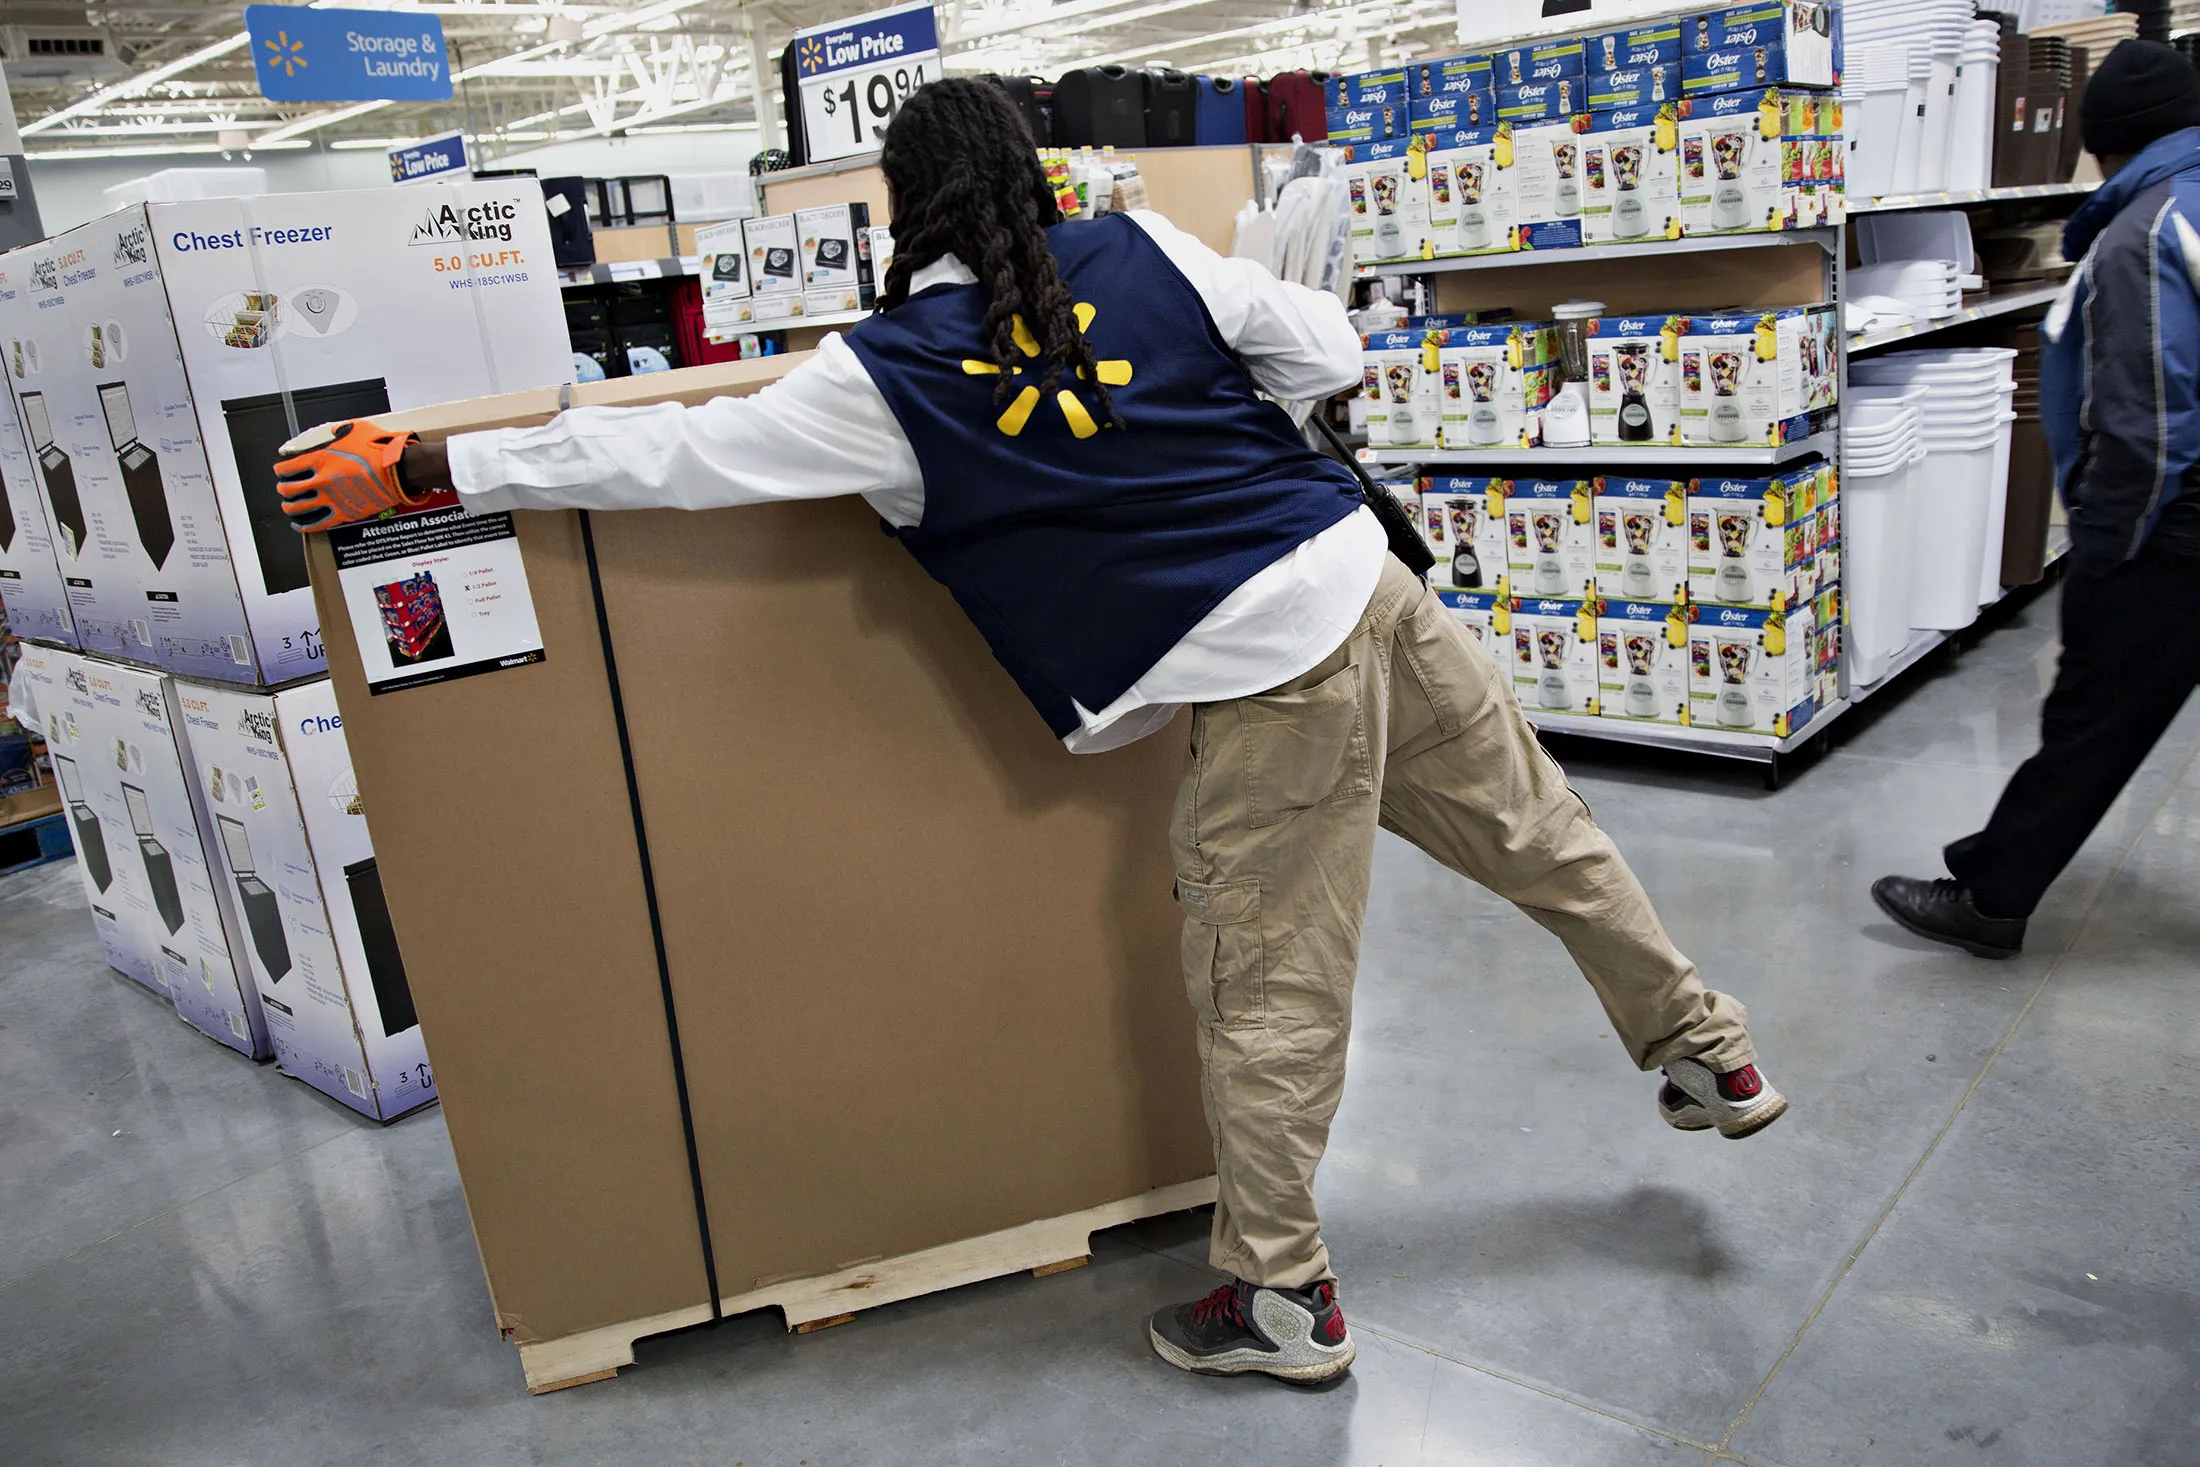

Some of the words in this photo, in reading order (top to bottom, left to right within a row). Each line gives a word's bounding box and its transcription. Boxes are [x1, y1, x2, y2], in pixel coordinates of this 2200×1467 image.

[825, 32, 854, 45] Everyday
[1724, 28, 1757, 45] Oster
[346, 31, 417, 57] Storage
[421, 33, 436, 54] &
[826, 43, 861, 67] Low
[861, 32, 904, 58] Price
[1628, 48, 1659, 64] Oster
[1706, 54, 1741, 70] Oster
[364, 56, 439, 82] Laundry
[1532, 64, 1562, 78] Oster
[1442, 78, 1471, 92] Oster
[1610, 71, 1640, 87] Oster
[1360, 90, 1386, 104] Oster
[1518, 84, 1548, 100] Oster
[1429, 98, 1457, 112] Oster
[1712, 97, 1742, 111] Oster
[1346, 111, 1373, 124] Oster
[1612, 111, 1638, 125] Oster
[1455, 130, 1480, 142] Oster
[1370, 144, 1394, 155] Oster
[405, 160, 425, 176] Low
[424, 152, 450, 171] Price
[439, 201, 516, 224] Arctic
[119, 227, 145, 250] Arctic
[173, 229, 244, 252] Chest
[248, 226, 332, 246] Freezer
[461, 222, 512, 242] King
[434, 256, 462, 272] 5.0
[468, 250, 524, 268] CU.FT.
[449, 272, 528, 289] WHS-185C1WSB
[1425, 317, 1448, 328] Oster
[1620, 320, 1645, 332] Oster
[1386, 334, 1410, 346] Oster
[1466, 330, 1492, 342] Oster
[1450, 478, 1473, 490] Oster
[1534, 482, 1558, 494] Oster
[1626, 481, 1652, 494] Oster
[1720, 480, 1748, 494] Oster
[362, 520, 418, 538] Attention
[412, 559, 432, 568] Display
[1457, 594, 1480, 605] Oster
[1538, 600, 1564, 612] Oster
[1626, 604, 1652, 616] Oster
[1720, 610, 1748, 622] Oster
[282, 636, 292, 649] 3
[500, 656, 528, 667] Walmart
[244, 708, 271, 728] Arctic
[400, 1072, 408, 1083] 3
